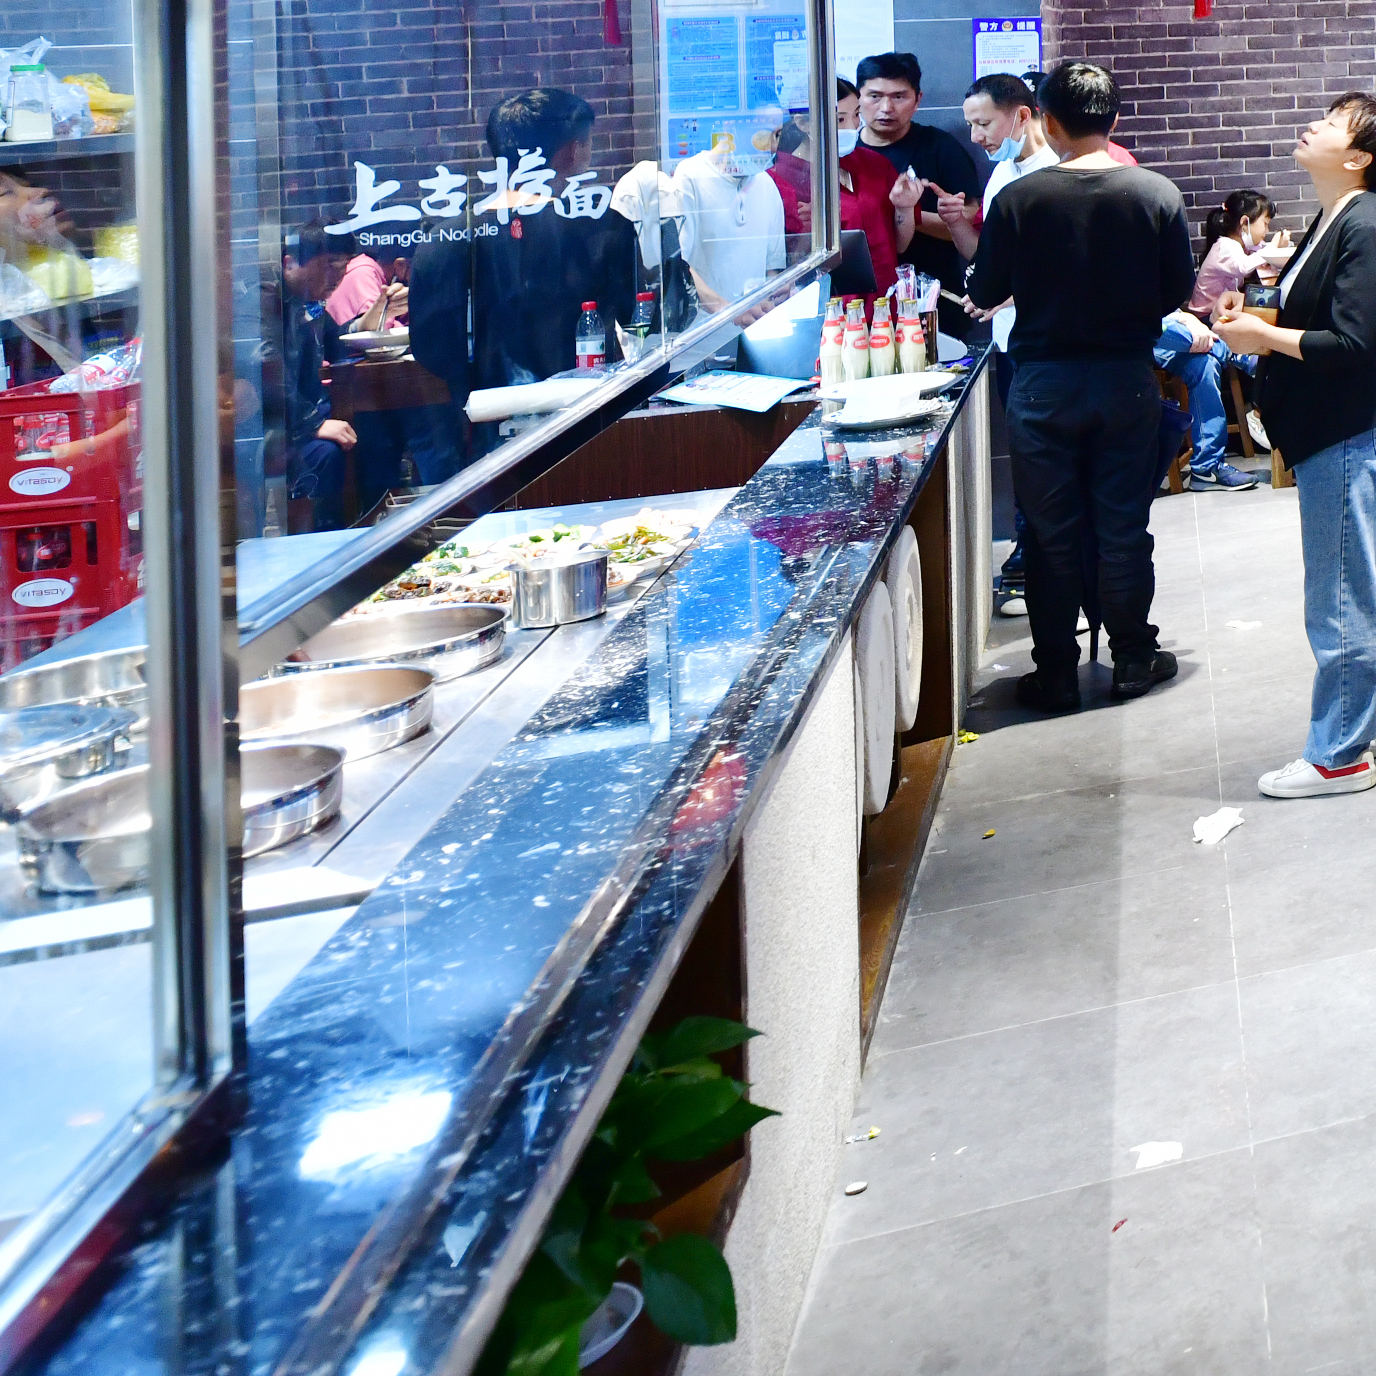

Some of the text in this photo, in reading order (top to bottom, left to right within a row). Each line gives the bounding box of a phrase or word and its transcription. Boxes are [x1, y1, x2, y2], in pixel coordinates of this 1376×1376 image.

[323, 147, 612, 235] 上古捞面
[17, 474, 63, 486] vitasoy
[20, 586, 66, 597] vitasoy
